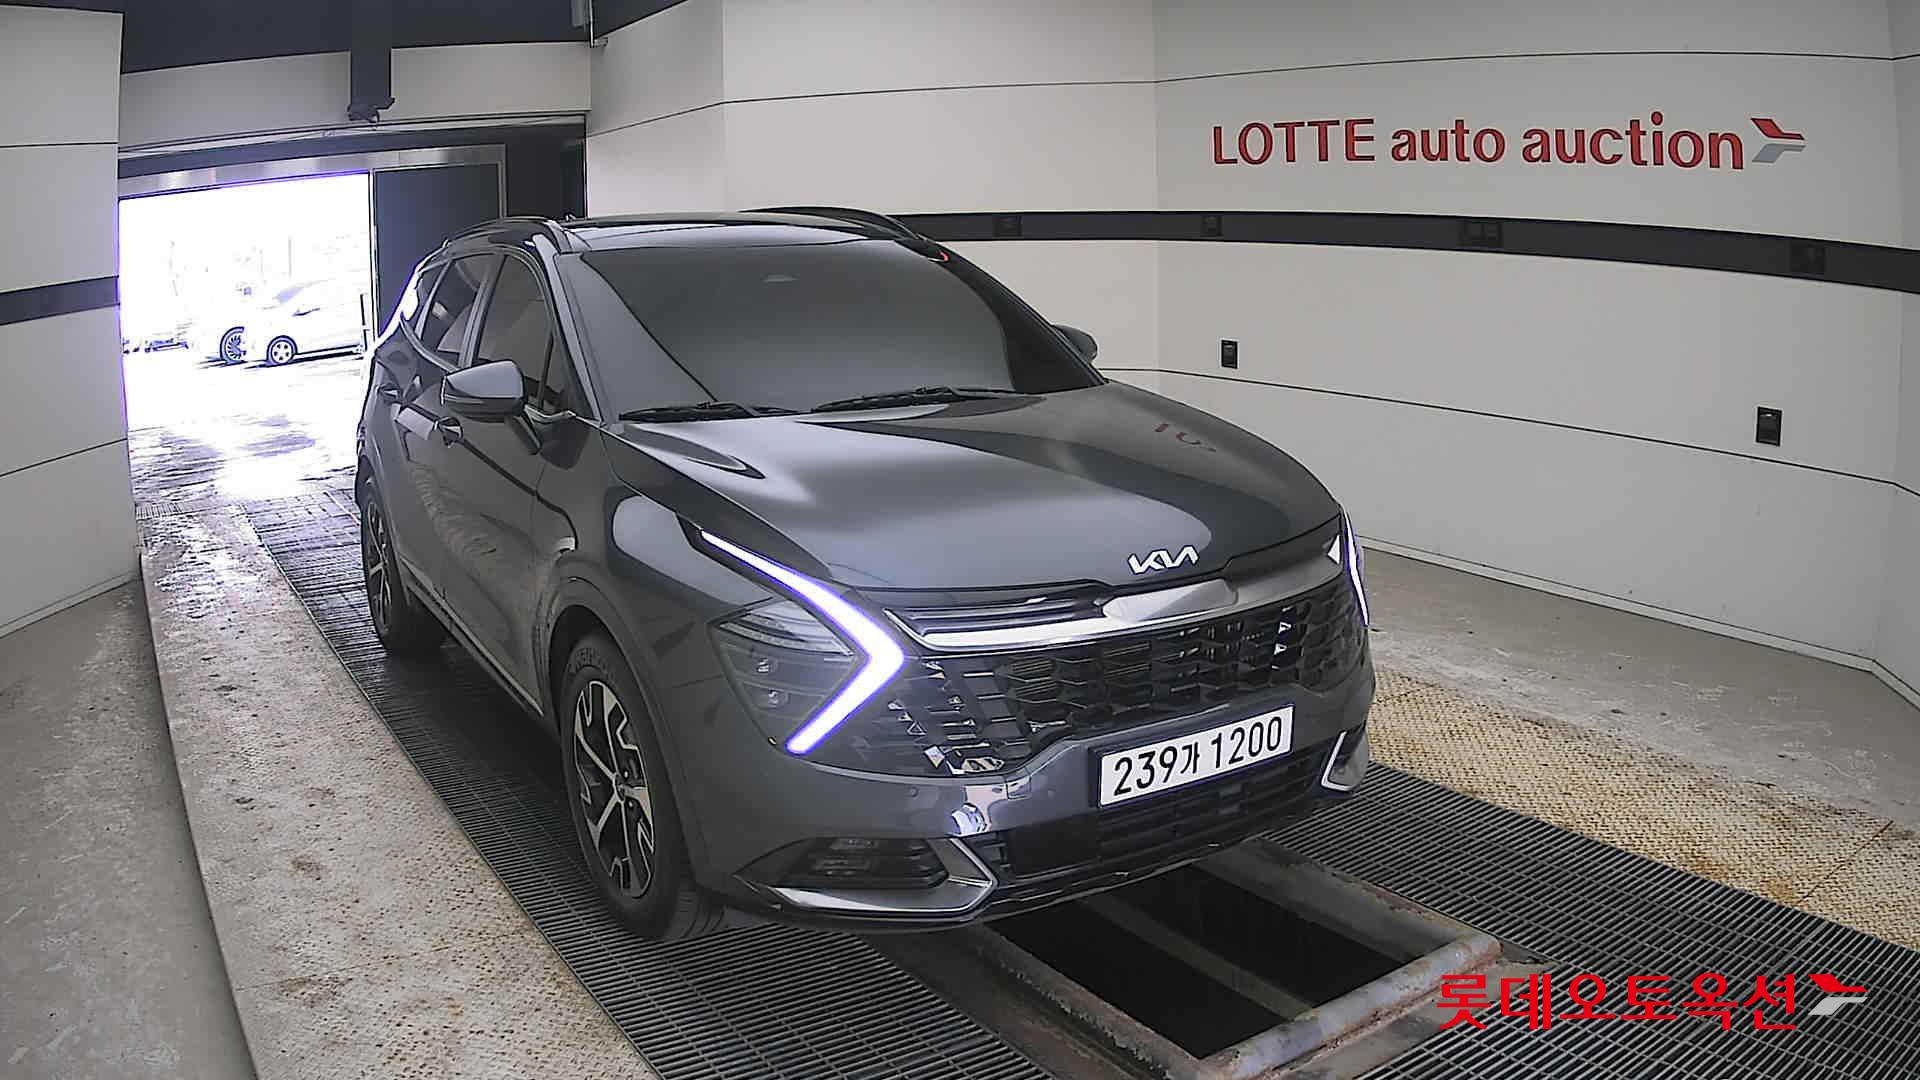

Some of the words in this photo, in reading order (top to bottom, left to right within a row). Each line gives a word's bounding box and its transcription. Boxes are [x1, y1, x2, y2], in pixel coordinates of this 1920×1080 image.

[1213, 118, 1375, 164] LOTTE
[1391, 119, 1505, 163] auto
[1522, 111, 1744, 170] auction
[1128, 545, 1200, 574] KIA
[1113, 741, 1200, 796] 239가
[1211, 716, 1282, 768] 1200
